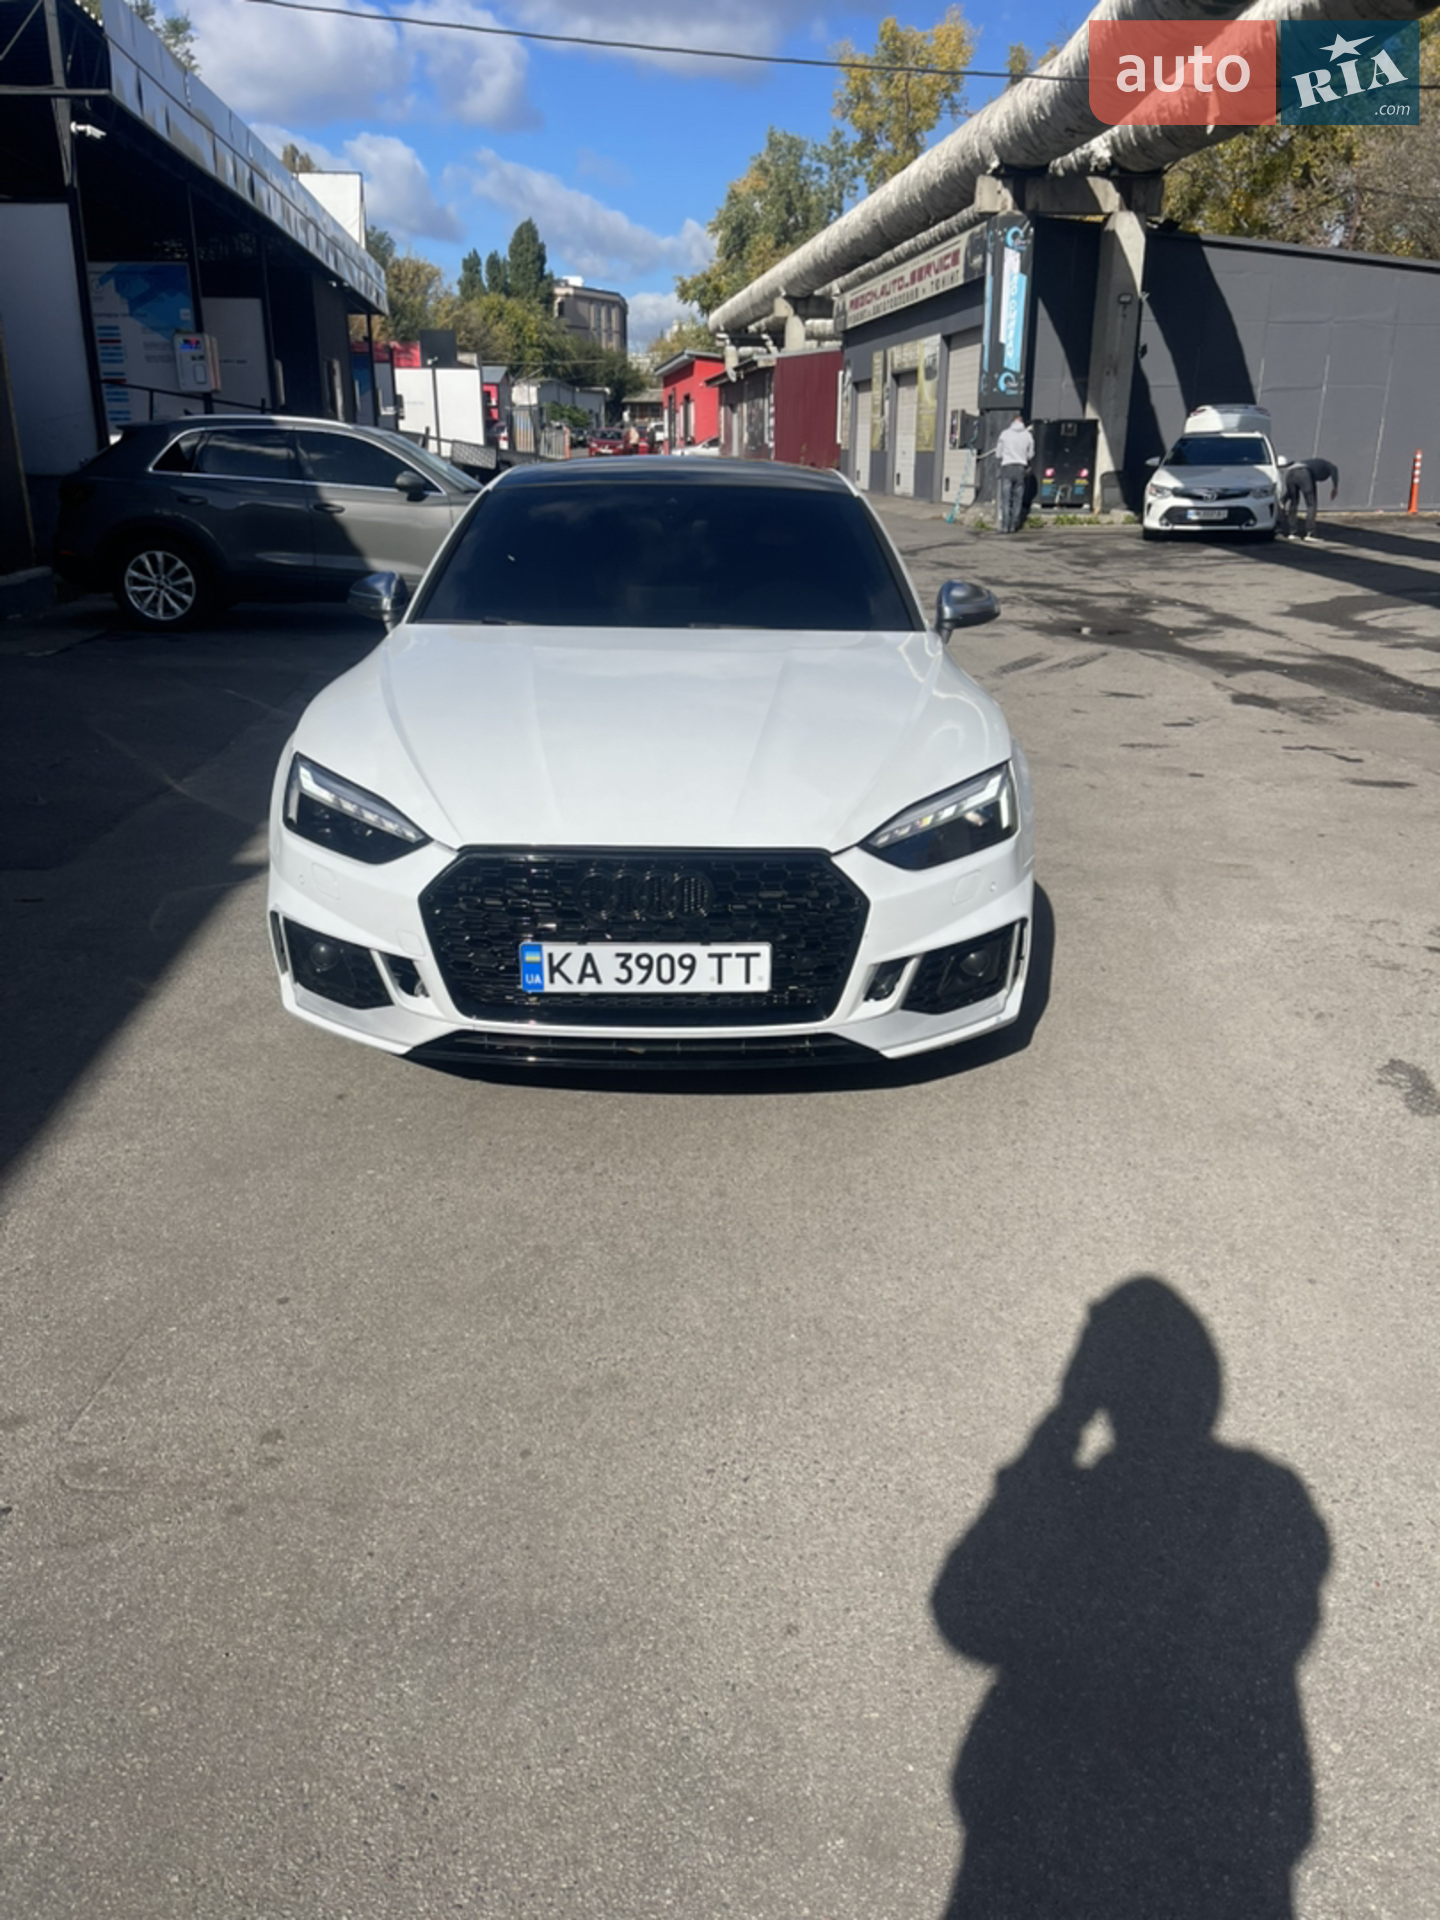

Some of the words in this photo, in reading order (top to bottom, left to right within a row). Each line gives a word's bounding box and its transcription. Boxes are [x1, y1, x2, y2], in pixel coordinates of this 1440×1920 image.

[525, 973, 542, 984] UA
[547, 952, 603, 985] KA
[614, 952, 697, 985] 3909
[707, 952, 761, 985] TT
